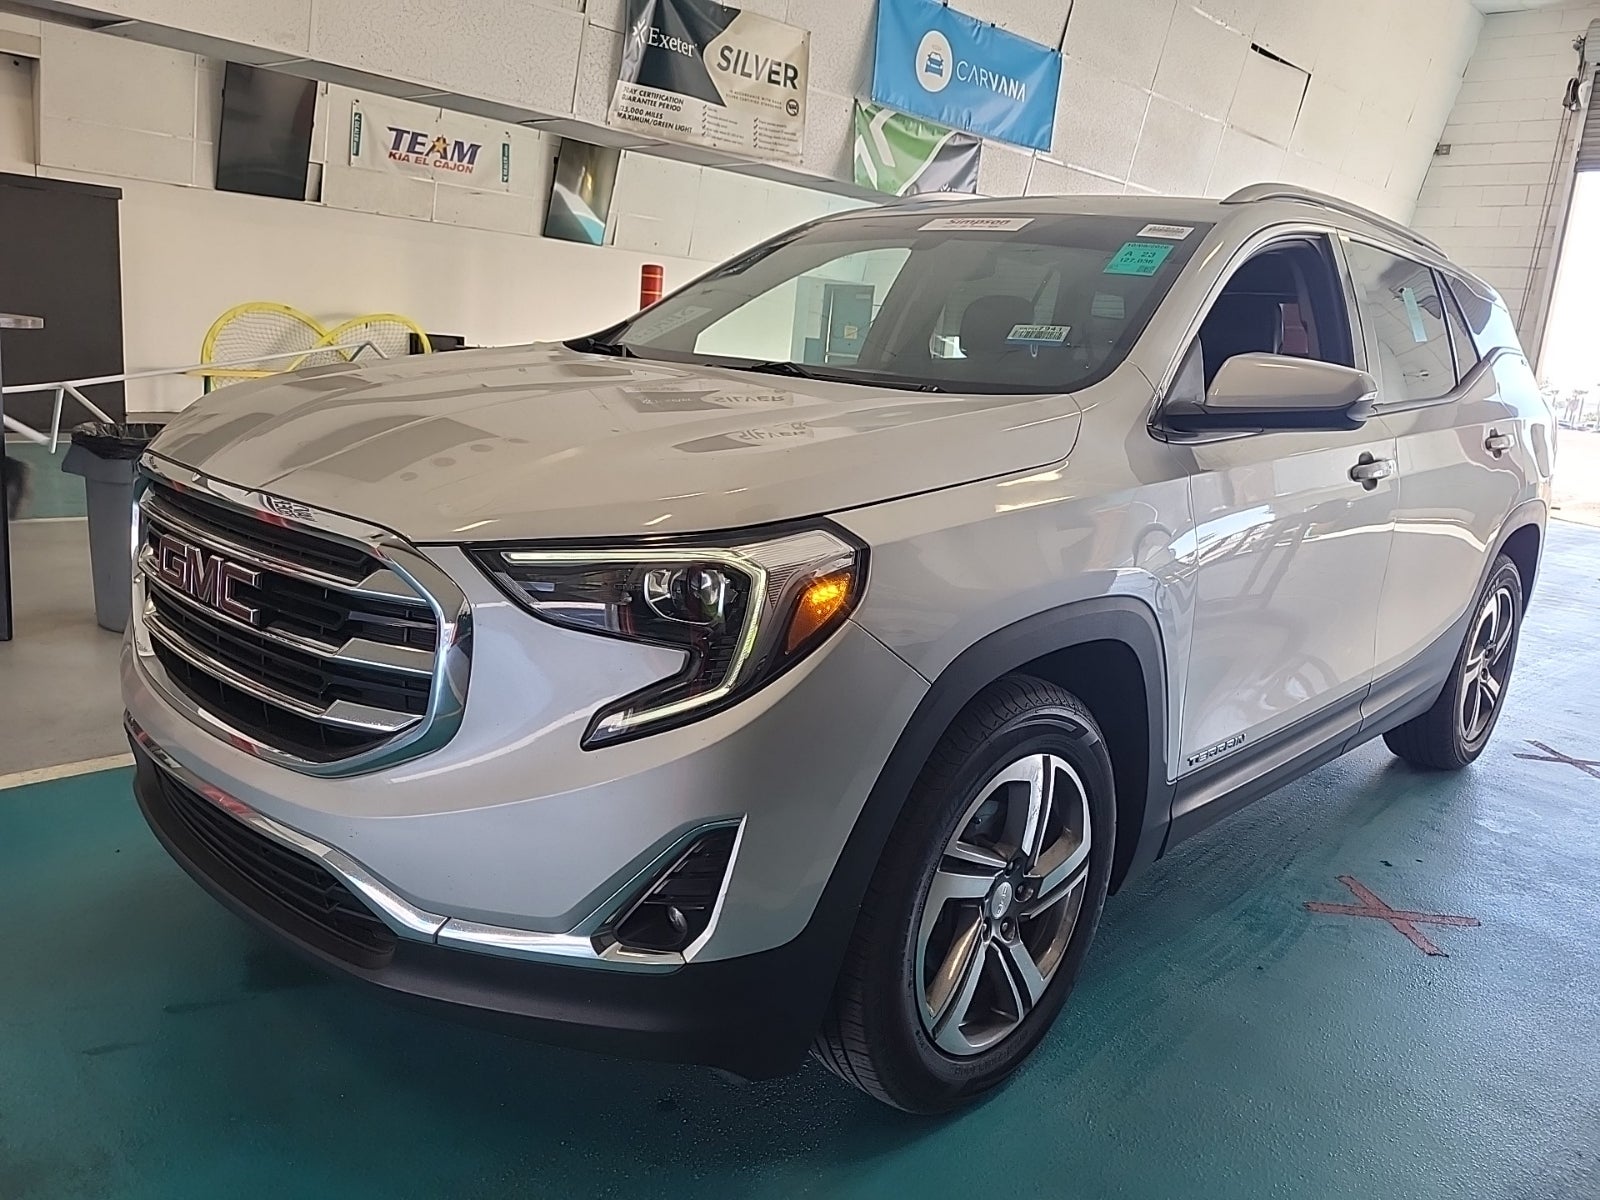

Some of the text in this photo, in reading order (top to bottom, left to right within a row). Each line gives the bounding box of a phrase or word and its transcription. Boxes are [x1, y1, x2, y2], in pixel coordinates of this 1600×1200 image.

[648, 27, 694, 57] Exeter
[716, 45, 799, 90] SILVER
[956, 60, 1028, 103] CARVANA
[639, 90, 684, 105] CERTIFICATION
[658, 102, 681, 112] PERIOD
[645, 110, 664, 120] MILES
[674, 124, 692, 134] LIGHT
[386, 125, 483, 165] TEAM
[388, 151, 474, 174] KIA EL CAJON
[948, 218, 1012, 226] Simpson
[158, 533, 263, 626] GMC
[1186, 732, 1247, 766] TERRAIN
